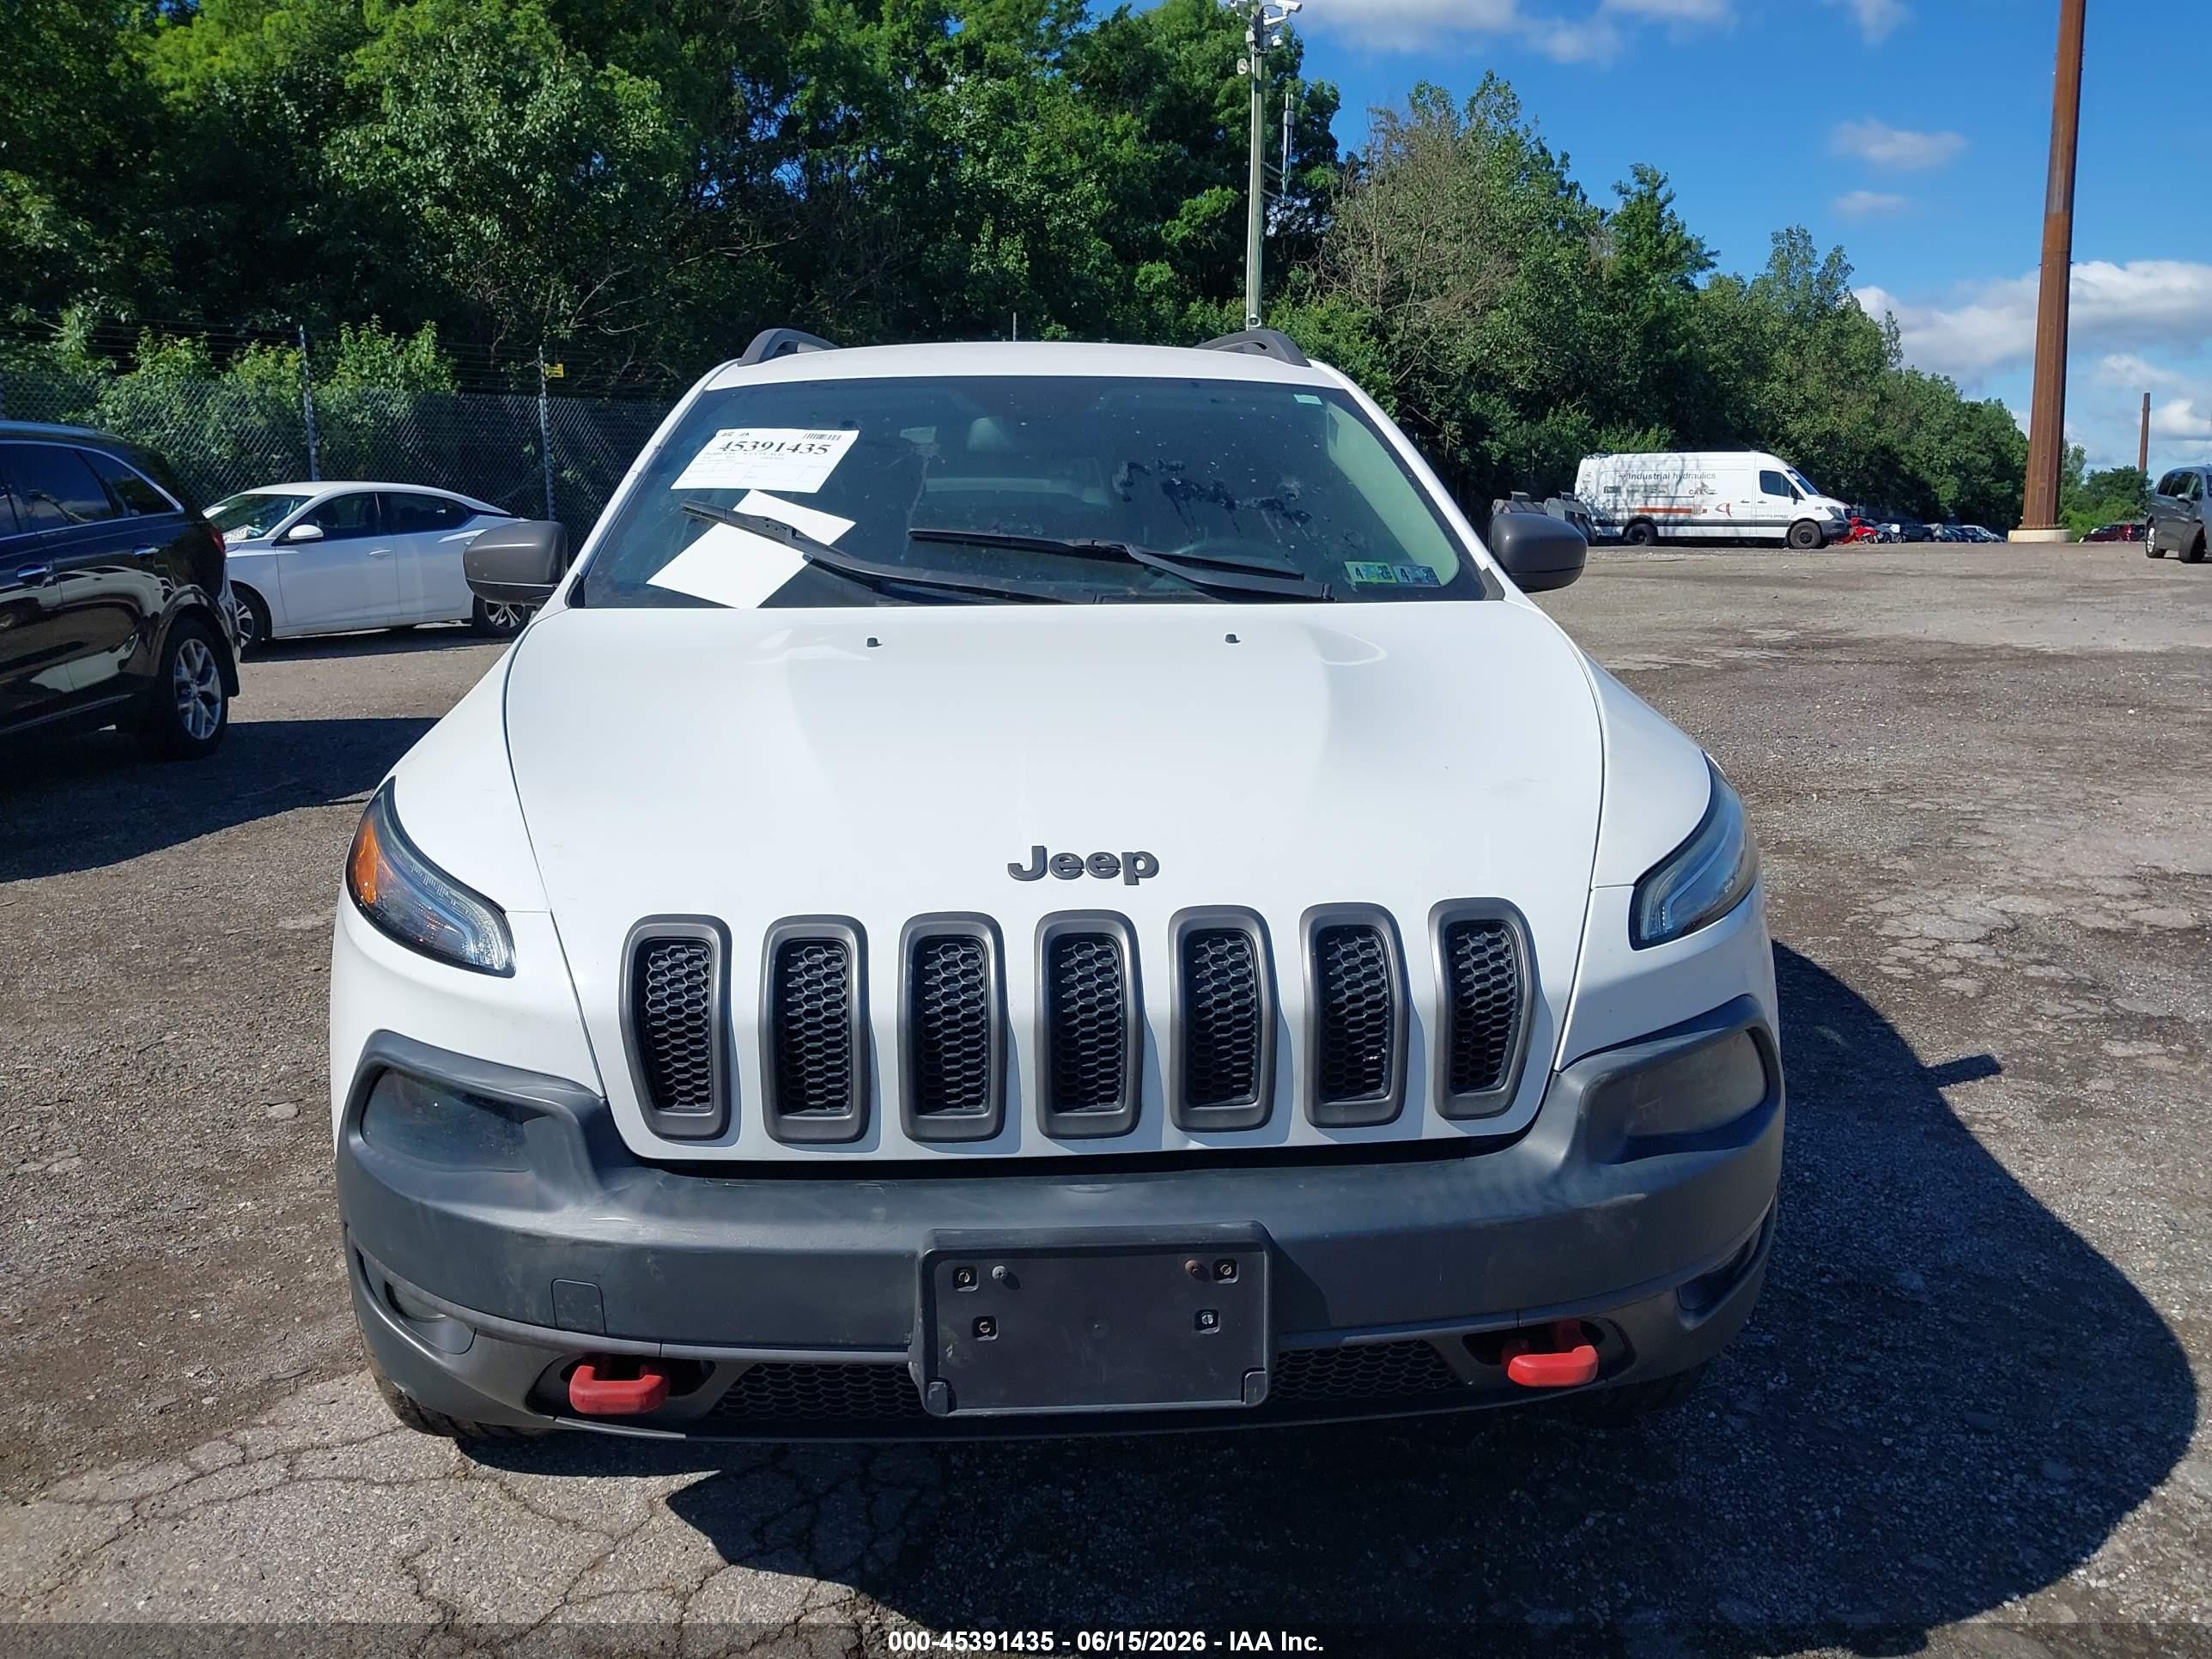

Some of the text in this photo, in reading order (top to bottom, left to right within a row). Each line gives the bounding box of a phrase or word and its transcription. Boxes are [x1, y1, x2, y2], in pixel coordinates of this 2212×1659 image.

[719, 441, 831, 455] 45391435
[1628, 471, 1717, 482] Industrial hydraulics
[1007, 845, 1160, 886] Jeep
